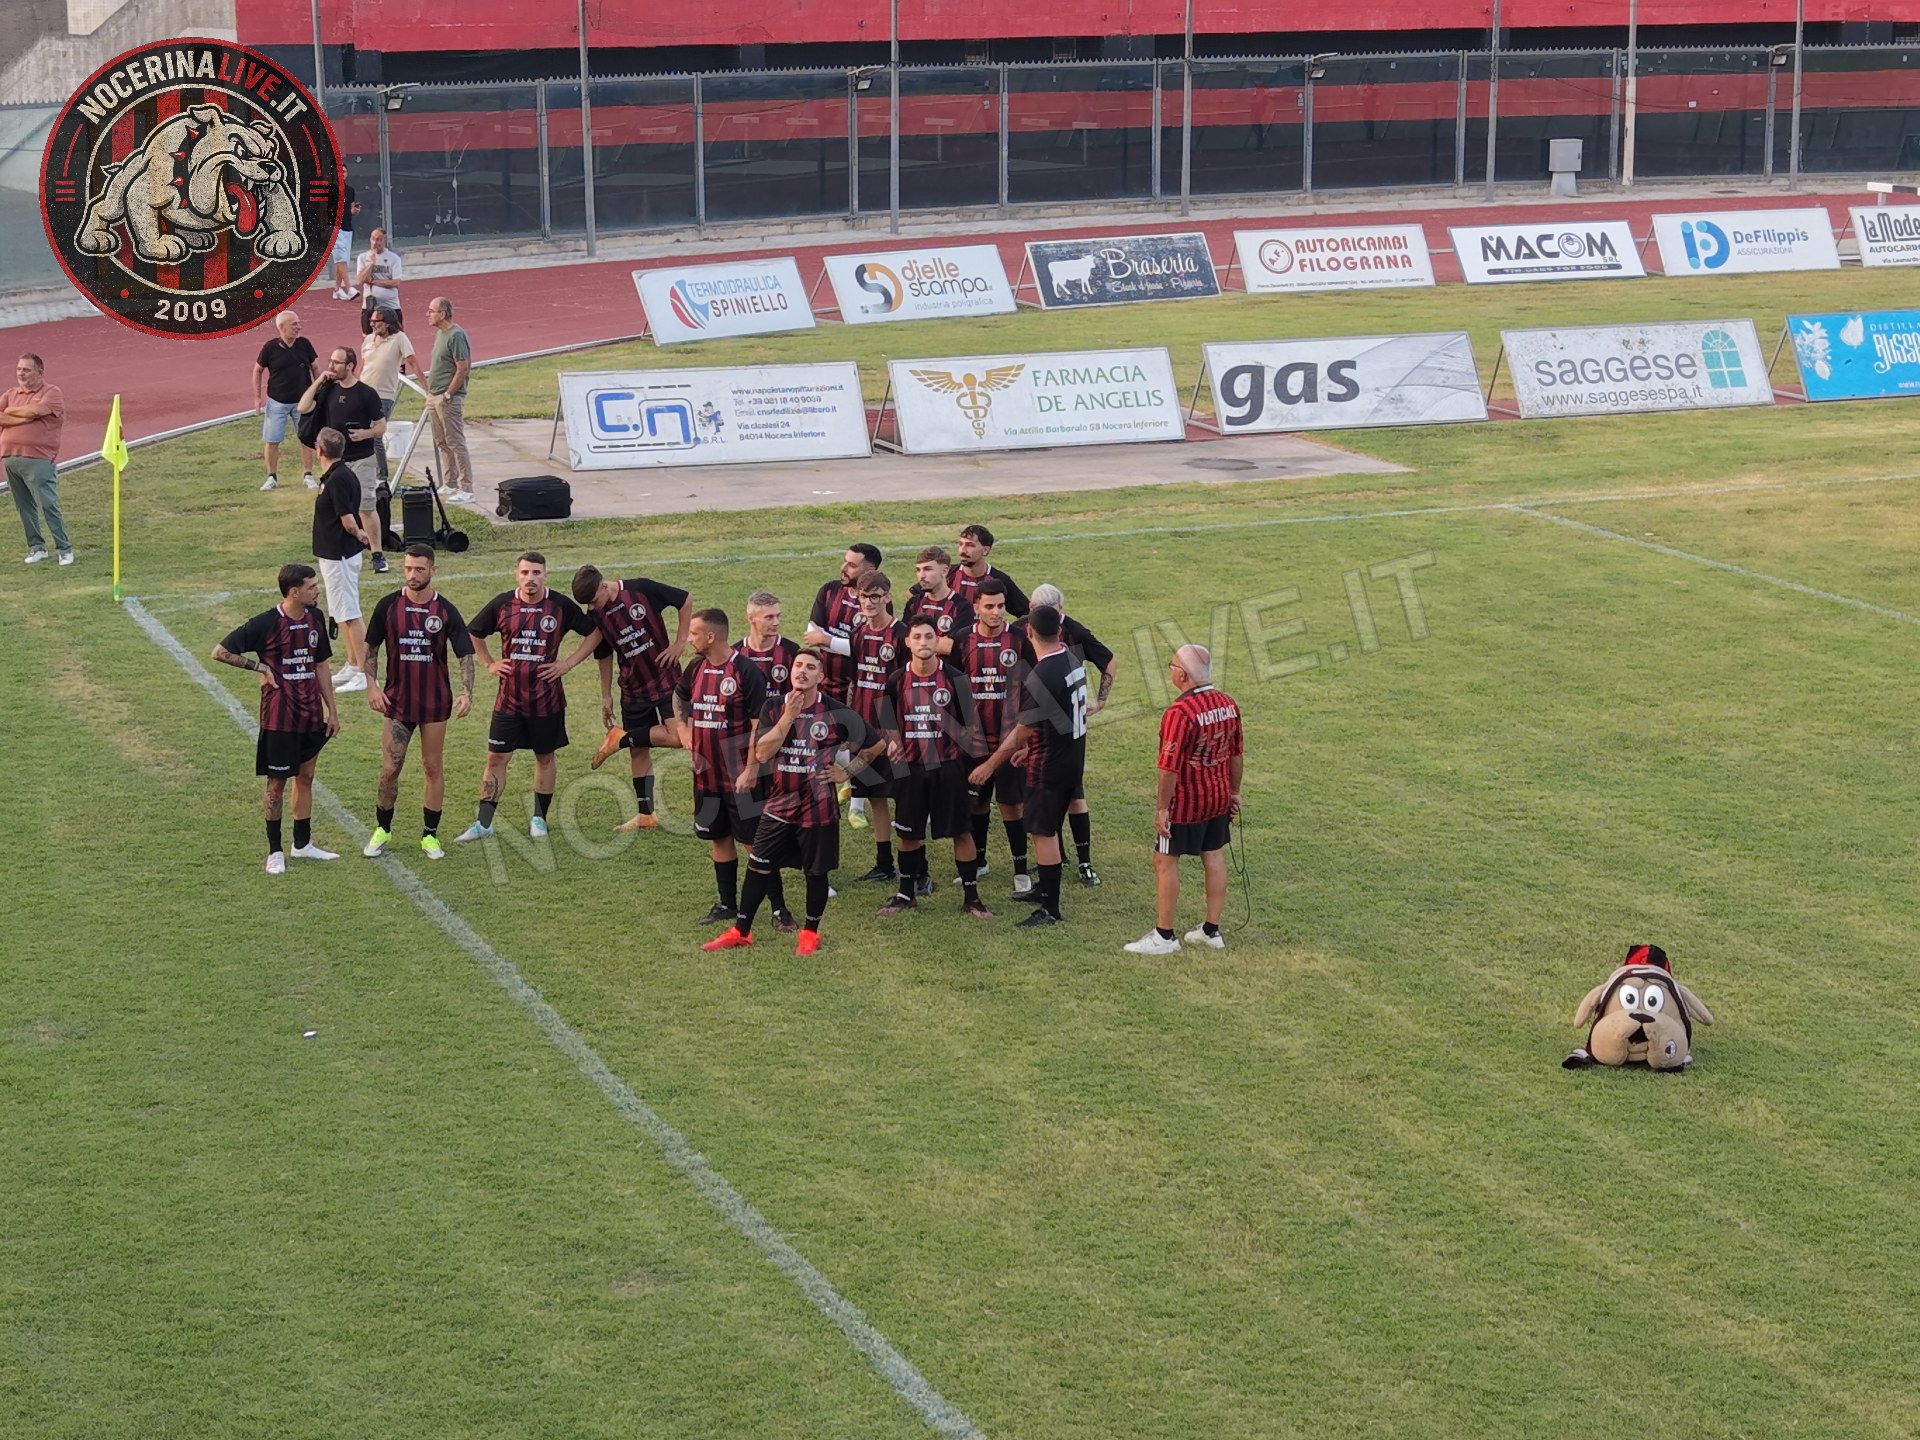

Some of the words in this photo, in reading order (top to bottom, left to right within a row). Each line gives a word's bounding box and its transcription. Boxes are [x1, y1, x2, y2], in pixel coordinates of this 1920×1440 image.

[1294, 235, 1409, 254] AUTORICAMBI
[1732, 228, 1809, 245] DeFilippis
[1480, 231, 1617, 262] MACOM
[1736, 246, 1793, 256] ASSICURAZIONI
[1869, 245, 1920, 253] AUTOCARR
[1100, 248, 1199, 279] Braseria
[1298, 254, 1413, 273] FILOGRANA
[1602, 255, 1620, 263] SRL
[901, 257, 960, 282] dielle
[687, 275, 783, 298] TERMOIDRAULICA
[710, 293, 788, 318] SPINIELLO
[914, 300, 950, 311] industria
[951, 297, 994, 309] poligrafica
[1032, 365, 1148, 388] FARMACIA
[1036, 394, 1066, 413] DE
[1073, 389, 1165, 412] ANGELIS
[1220, 359, 1360, 427] gas
[1541, 384, 1703, 406] www.saggesespa.it
[1004, 427, 1018, 436] Via
[1102, 421, 1132, 430] Nocera
[1133, 419, 1169, 430] Inferiore
[410, 646, 421, 654] LA
[521, 645, 531, 653] LA
[703, 694, 718, 703] VIVE
[703, 712, 713, 720] LA
[914, 705, 931, 713] VIVE
[917, 722, 928, 730] LA
[789, 756, 800, 764] LA
